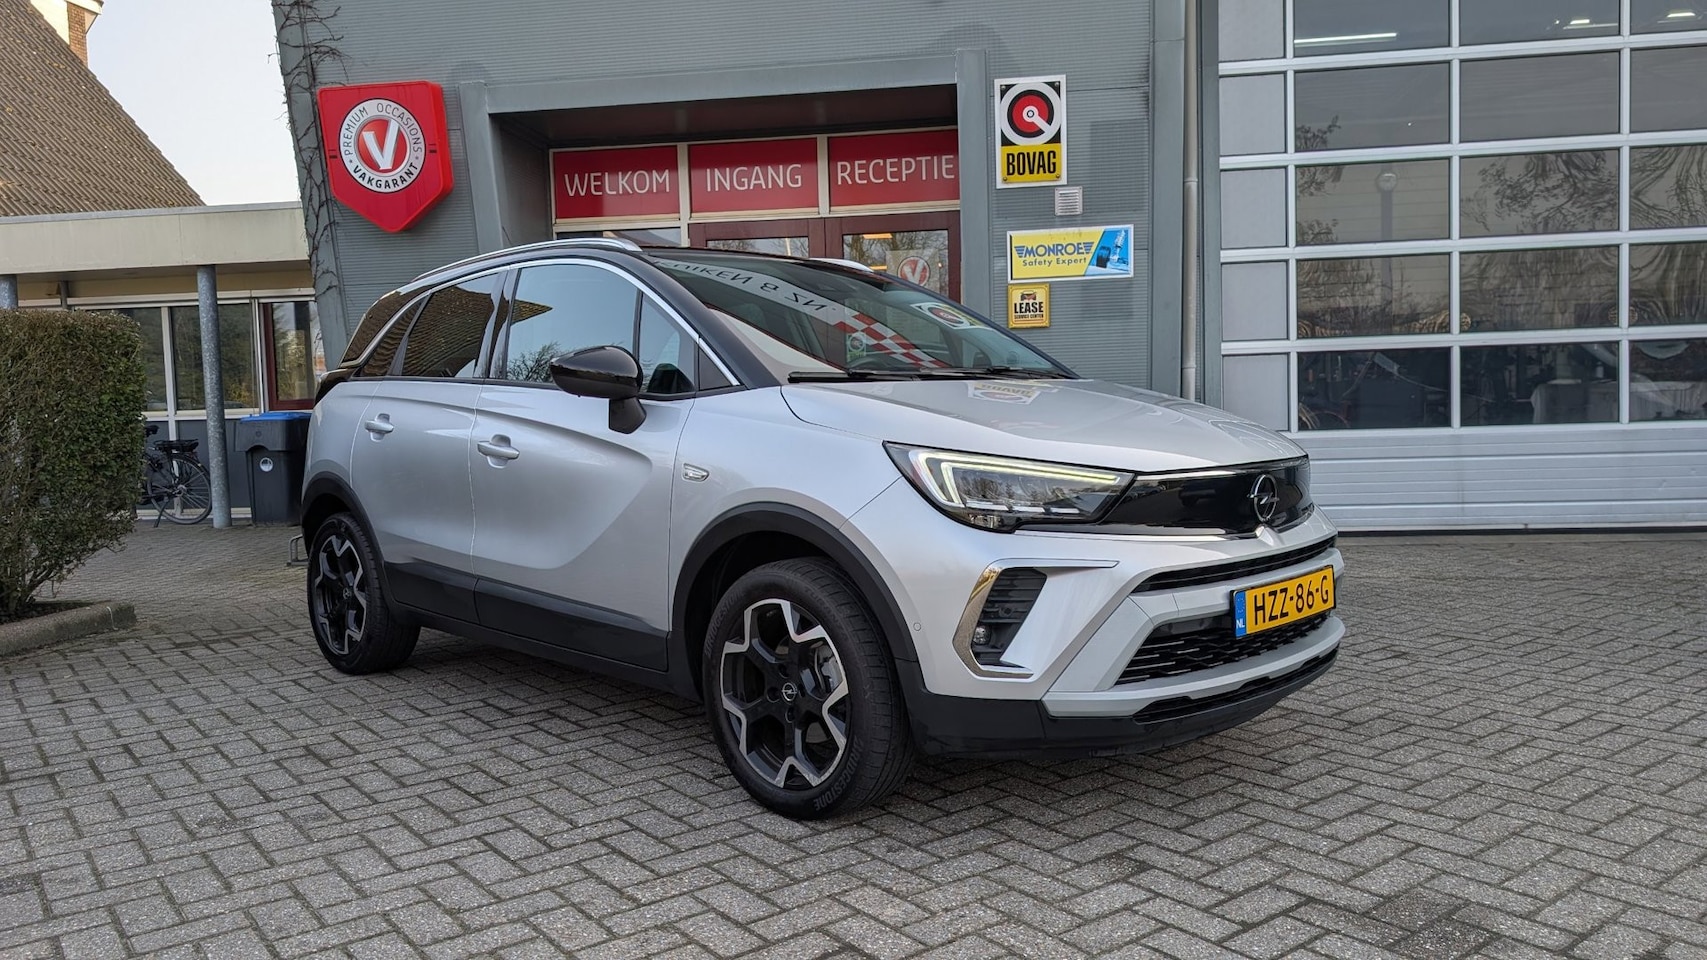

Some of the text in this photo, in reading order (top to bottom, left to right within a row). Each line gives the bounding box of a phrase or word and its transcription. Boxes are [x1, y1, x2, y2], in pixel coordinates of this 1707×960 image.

[343, 102, 423, 156] PREMIUM OCCASIONS
[353, 162, 418, 189] VAKGARANT
[837, 155, 955, 185] RECEPTIE
[1006, 150, 1056, 176] BOVAG
[564, 169, 671, 196] WELKOM
[706, 164, 802, 192] INGANG
[1022, 257, 1086, 267] Safety Expert
[1024, 242, 1084, 258] MONROE
[1014, 302, 1044, 313] LEASE
[1254, 575, 1329, 625] HZZ-86-G
[1236, 618, 1245, 628] NL
